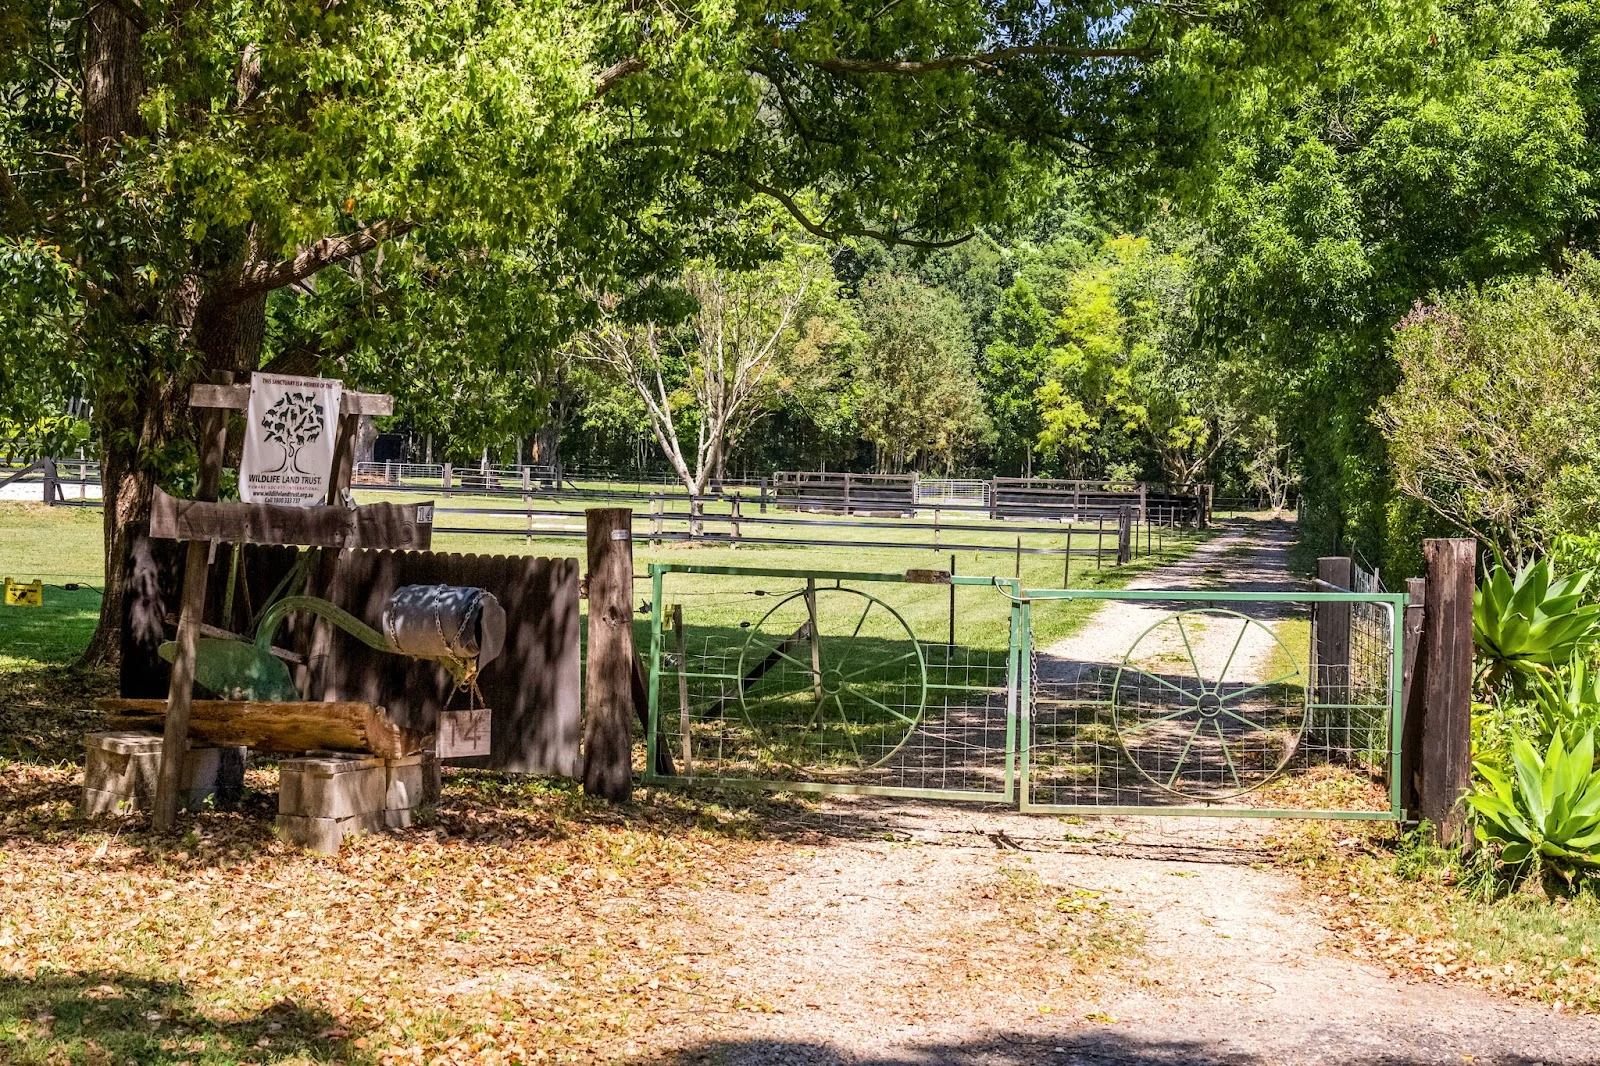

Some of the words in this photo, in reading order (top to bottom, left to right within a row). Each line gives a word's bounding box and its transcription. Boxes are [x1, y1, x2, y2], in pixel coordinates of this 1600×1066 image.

[249, 474, 280, 483] WILDLIFE
[282, 476, 299, 484] LAND
[253, 491, 313, 499] www.wildlifelandtrust.org.au
[418, 507, 433, 521] 14
[447, 713, 481, 750] 14
